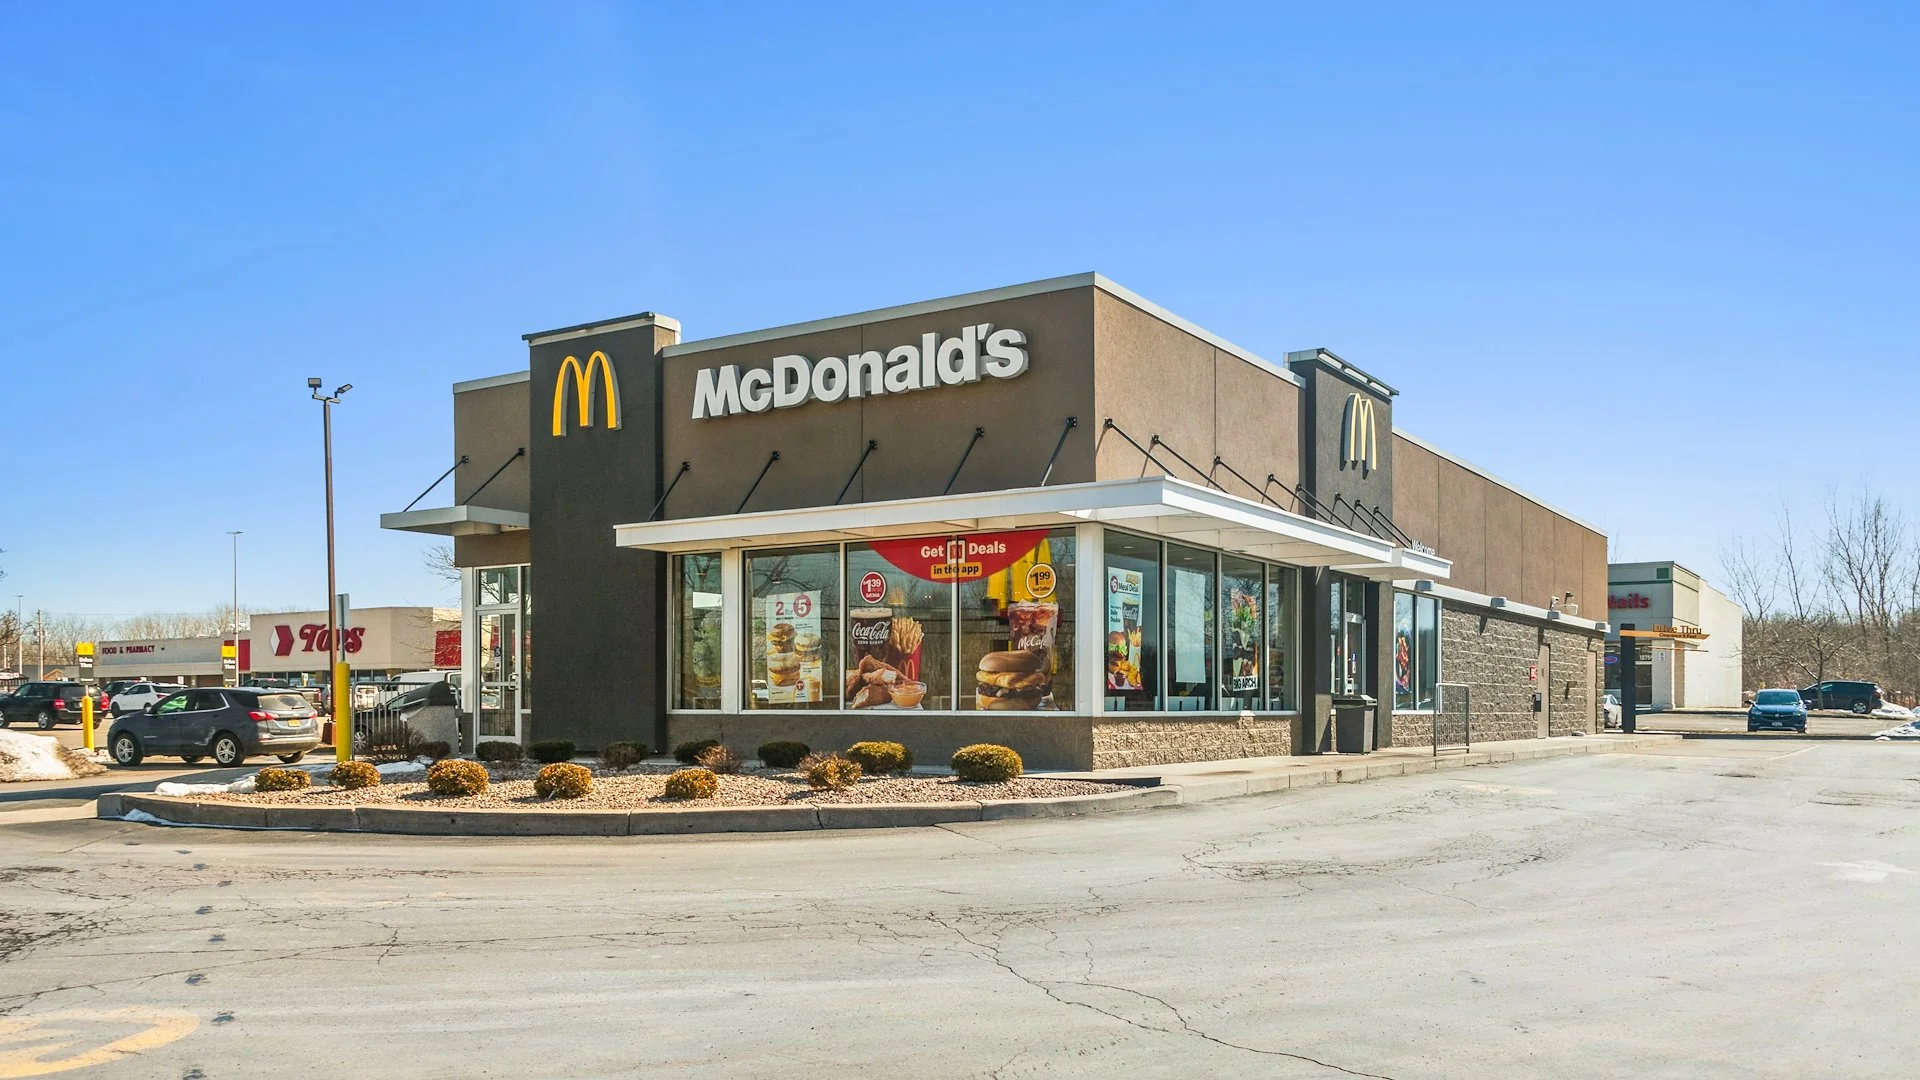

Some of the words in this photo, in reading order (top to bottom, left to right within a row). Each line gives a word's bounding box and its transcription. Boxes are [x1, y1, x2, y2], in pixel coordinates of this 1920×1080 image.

[691, 322, 1029, 420] McDonald's
[920, 545, 944, 558] Get
[968, 541, 1007, 556] Deals
[933, 566, 943, 575] in
[961, 565, 980, 575] app
[1118, 582, 1129, 591] Meal
[1129, 584, 1139, 593] Deal
[775, 601, 785, 616] 2
[852, 621, 891, 640] Coca-Cola
[1653, 623, 1678, 633] Drive
[1680, 625, 1702, 635] Thru
[102, 647, 118, 655] FOOD
[126, 645, 156, 654] PHARMACY
